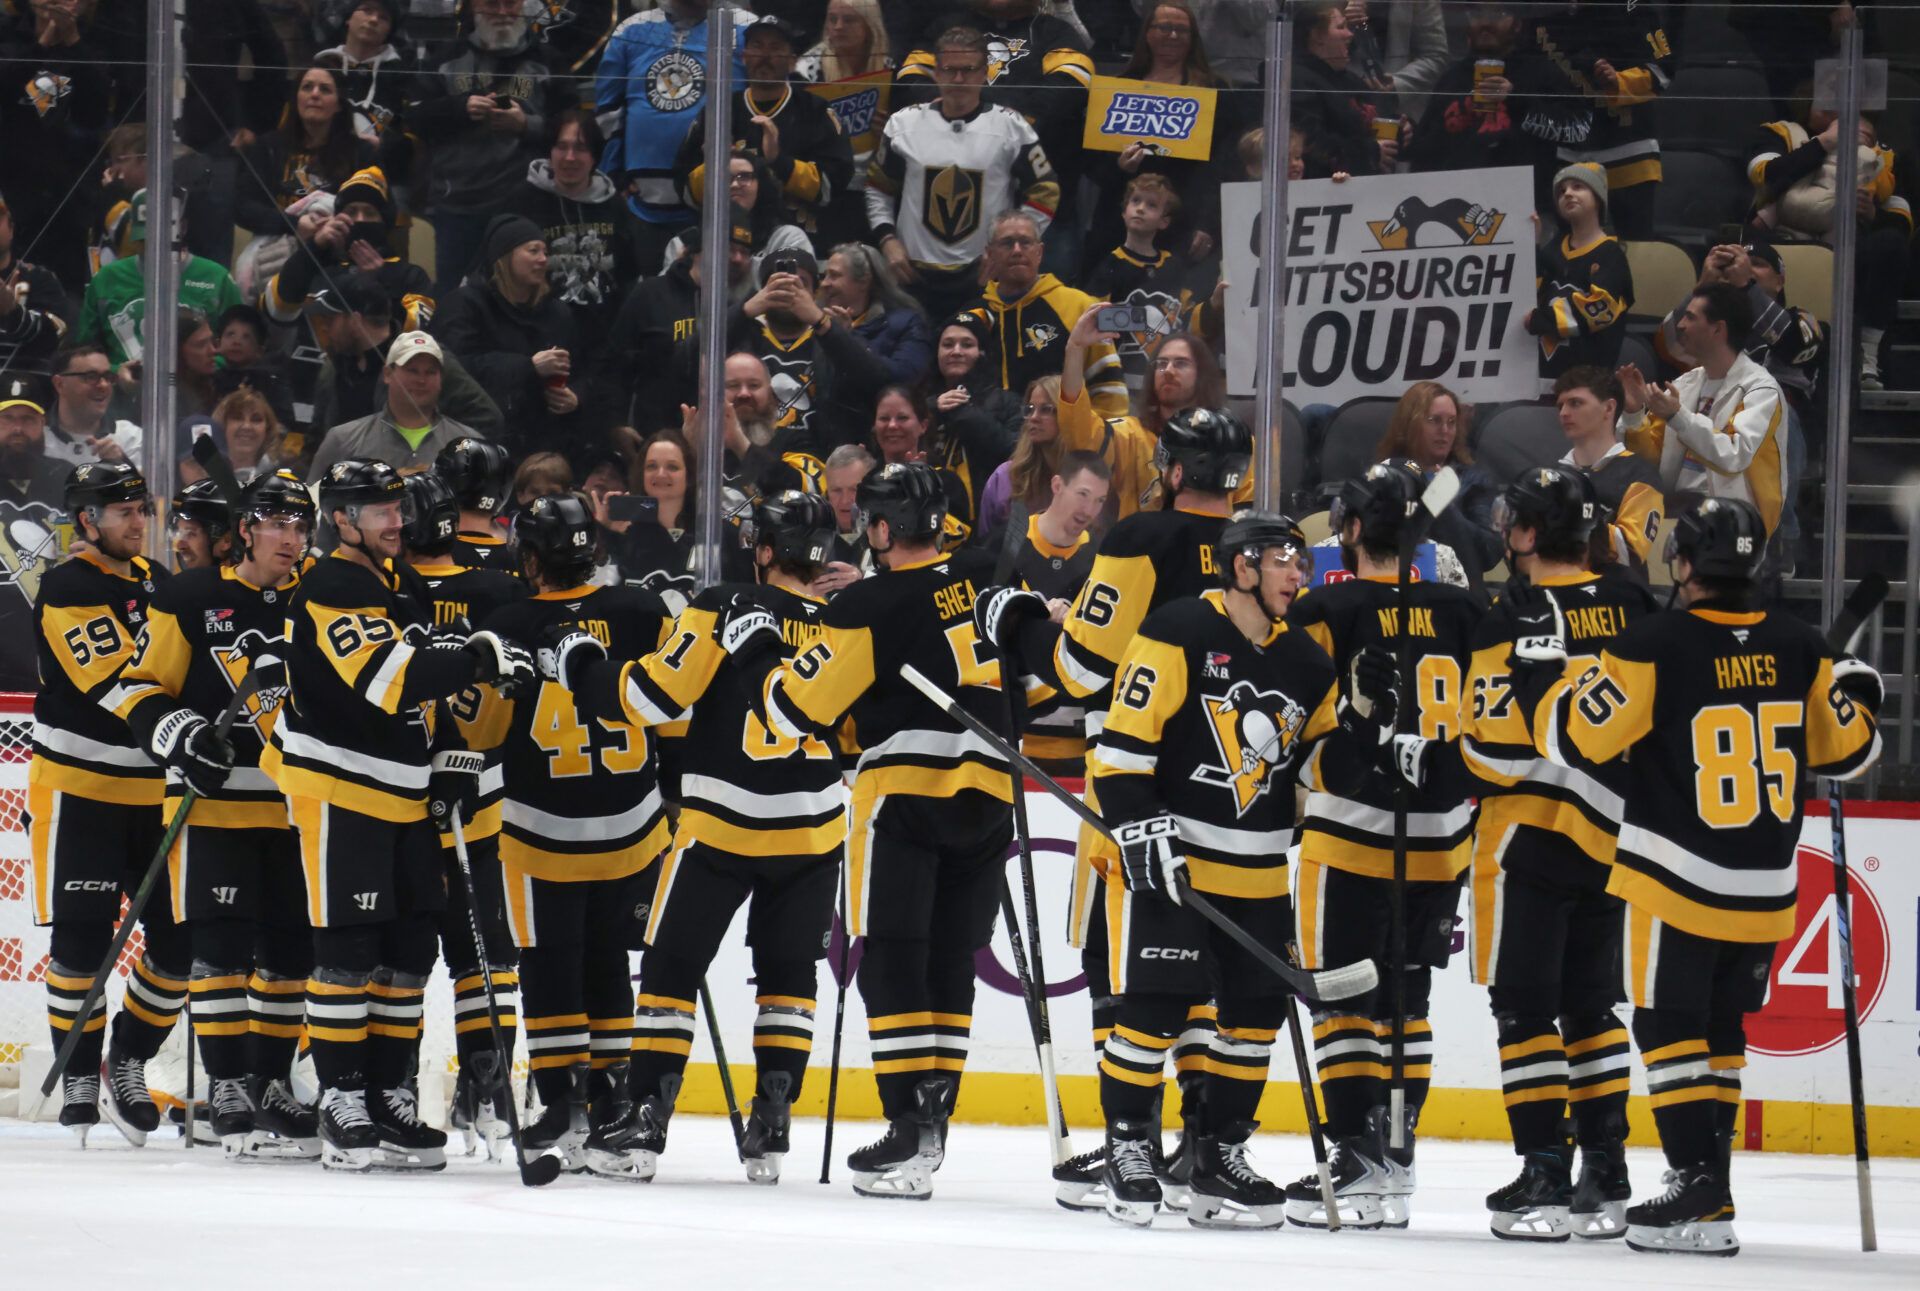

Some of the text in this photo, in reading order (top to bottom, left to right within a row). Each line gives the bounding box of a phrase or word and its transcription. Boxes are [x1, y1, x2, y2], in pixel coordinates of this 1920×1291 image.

[648, 89, 701, 110] PENGUINS
[1114, 96, 1196, 115] LET'S GO
[1105, 111, 1192, 136] PENS!
[185, 279, 216, 290] Reebok
[1250, 253, 1516, 307] ITTSBURGH
[1225, 473, 1238, 489] 16
[478, 496, 495, 510] 39
[438, 520, 452, 537] 75
[930, 514, 938, 529] 5
[572, 531, 587, 547] 49
[1736, 536, 1753, 554] 85
[809, 546, 823, 561] 81
[64, 614, 122, 668] 59
[326, 614, 396, 660] 65
[792, 641, 833, 682] 5
[1715, 654, 1777, 690] HAYES
[1691, 701, 1803, 829] 85
[64, 880, 119, 892] CCM
[1139, 947, 1200, 961] CCM
